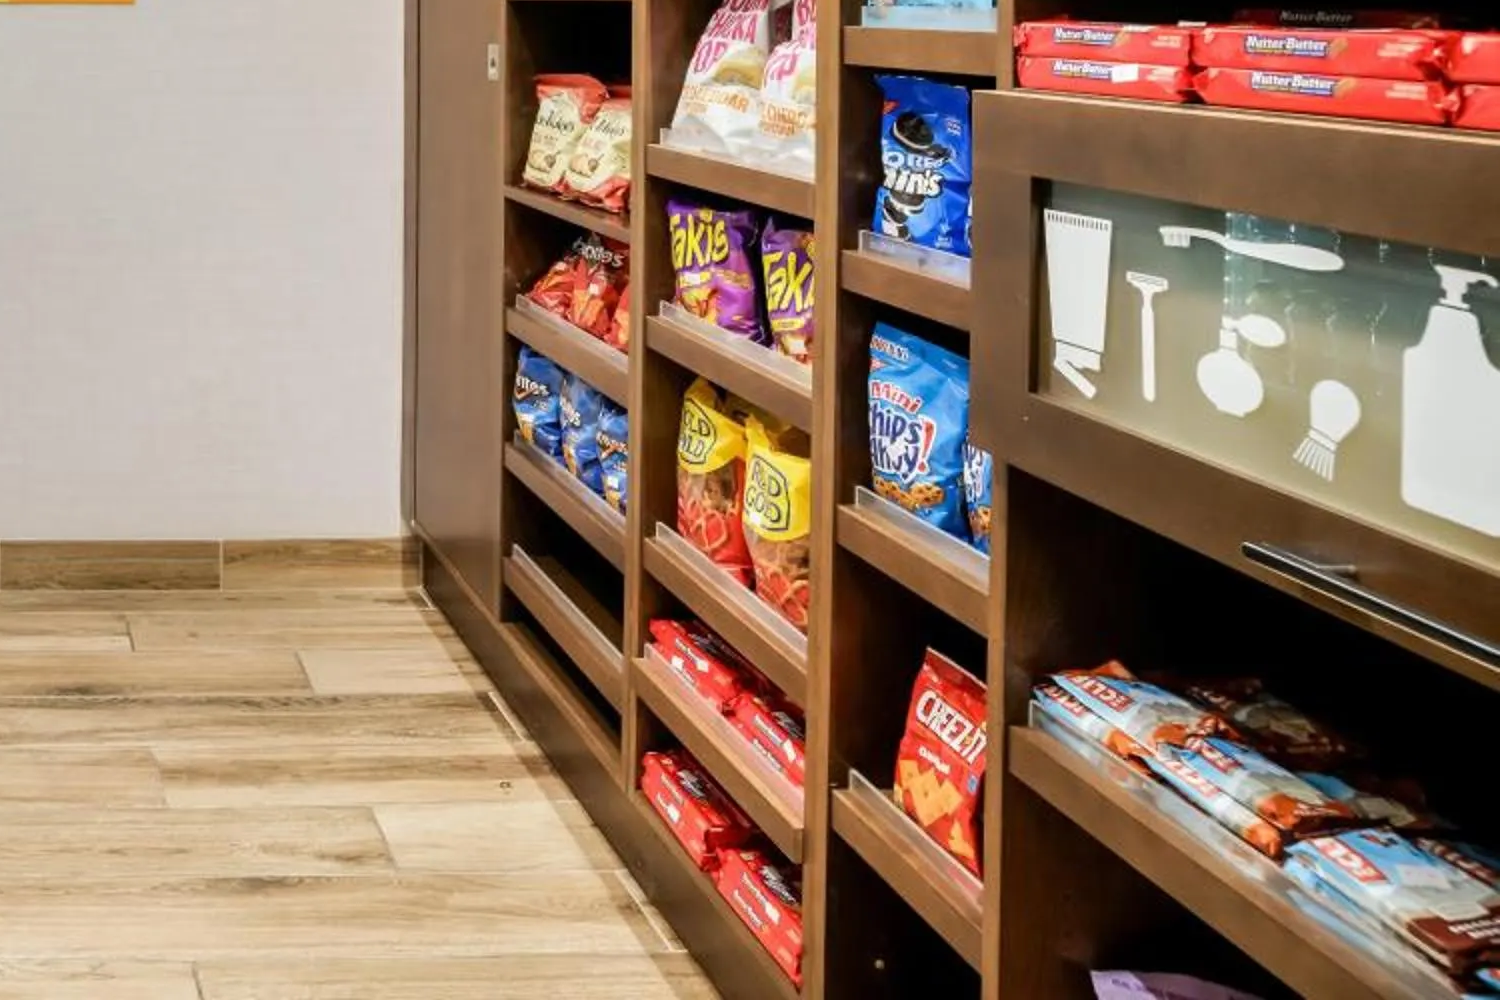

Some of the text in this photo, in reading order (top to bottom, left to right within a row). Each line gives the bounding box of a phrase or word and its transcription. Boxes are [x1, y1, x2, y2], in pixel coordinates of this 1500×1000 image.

[1054, 27, 1115, 42] Nutter Butter
[1245, 35, 1328, 52] Nutter Butter
[1252, 71, 1336, 90] Nutter Butter
[670, 209, 730, 270] Takis
[870, 380, 922, 414] Mini
[870, 401, 922, 444] hips
